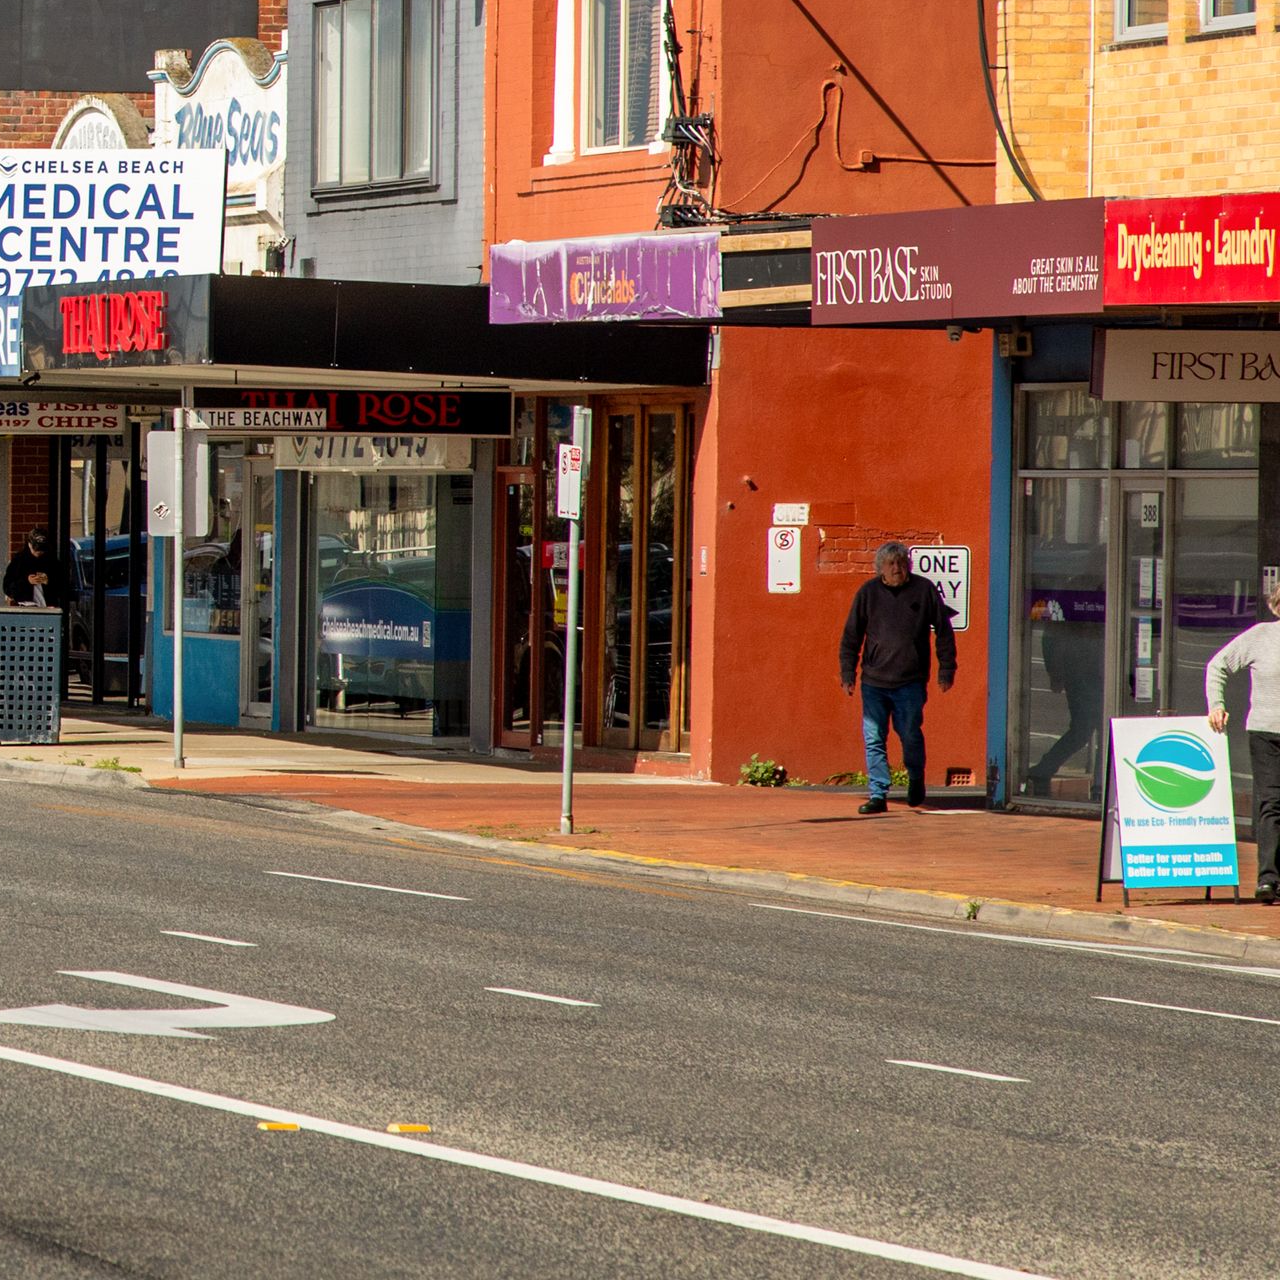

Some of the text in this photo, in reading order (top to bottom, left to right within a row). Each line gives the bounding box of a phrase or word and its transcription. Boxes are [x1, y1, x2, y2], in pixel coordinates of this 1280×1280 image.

[21, 160, 184, 174] CHELSEA BEACH
[1117, 216, 1276, 282] Drycleaning Laundry
[1030, 255, 1099, 275] GREAT SKIN IS ALL
[816, 246, 939, 306] FIRST BASE SKIN
[1012, 274, 1099, 295] ABOUT THE CHEMISTRY
[920, 283, 952, 300] STUDIO
[60, 293, 111, 361] THAI
[1152, 352, 1234, 381] FIRST
[209, 411, 324, 426] THE BEACHWAY
[357, 394, 461, 426] ROSE
[37, 415, 119, 429] CHIPS
[1143, 505, 1158, 523] 388
[919, 555, 959, 573] ONE
[937, 580, 962, 599] AY
[1124, 817, 1135, 827] We
[1137, 818, 1149, 827] use
[1168, 816, 1197, 827] Friendly
[1198, 816, 1230, 826] Products
[1126, 852, 1223, 864] Better for your health
[1127, 865, 1233, 877] Better for your garment
